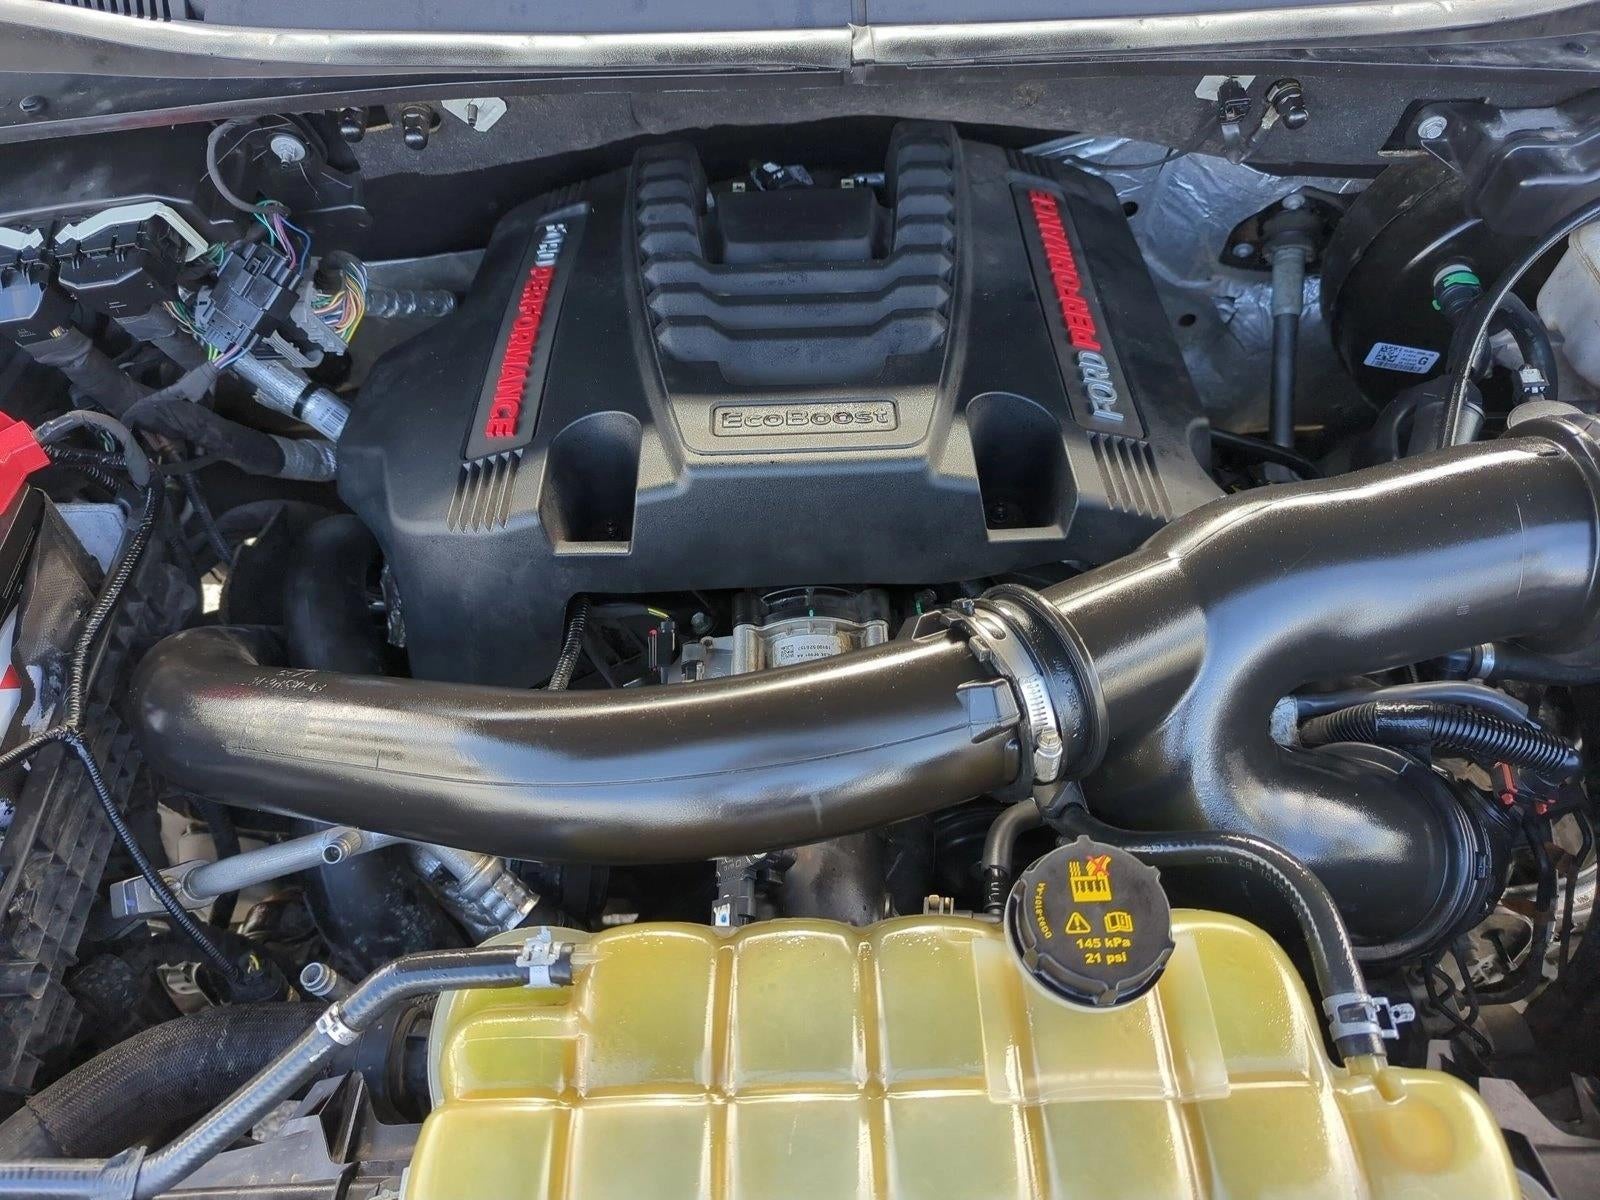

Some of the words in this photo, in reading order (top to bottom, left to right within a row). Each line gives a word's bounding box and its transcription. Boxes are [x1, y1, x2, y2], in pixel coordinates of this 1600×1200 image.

[535, 224, 567, 267] FORD
[1029, 189, 1102, 351] PERFORMANCE
[485, 267, 555, 438] PERFORMANCE
[1418, 357, 1429, 365] G
[1078, 350, 1124, 421] FORD
[721, 408, 888, 429] EcoBoost
[1076, 938, 1102, 949] 145
[1104, 936, 1131, 949] kPa
[1085, 952, 1102, 964] 21
[1106, 951, 1127, 966] psi
